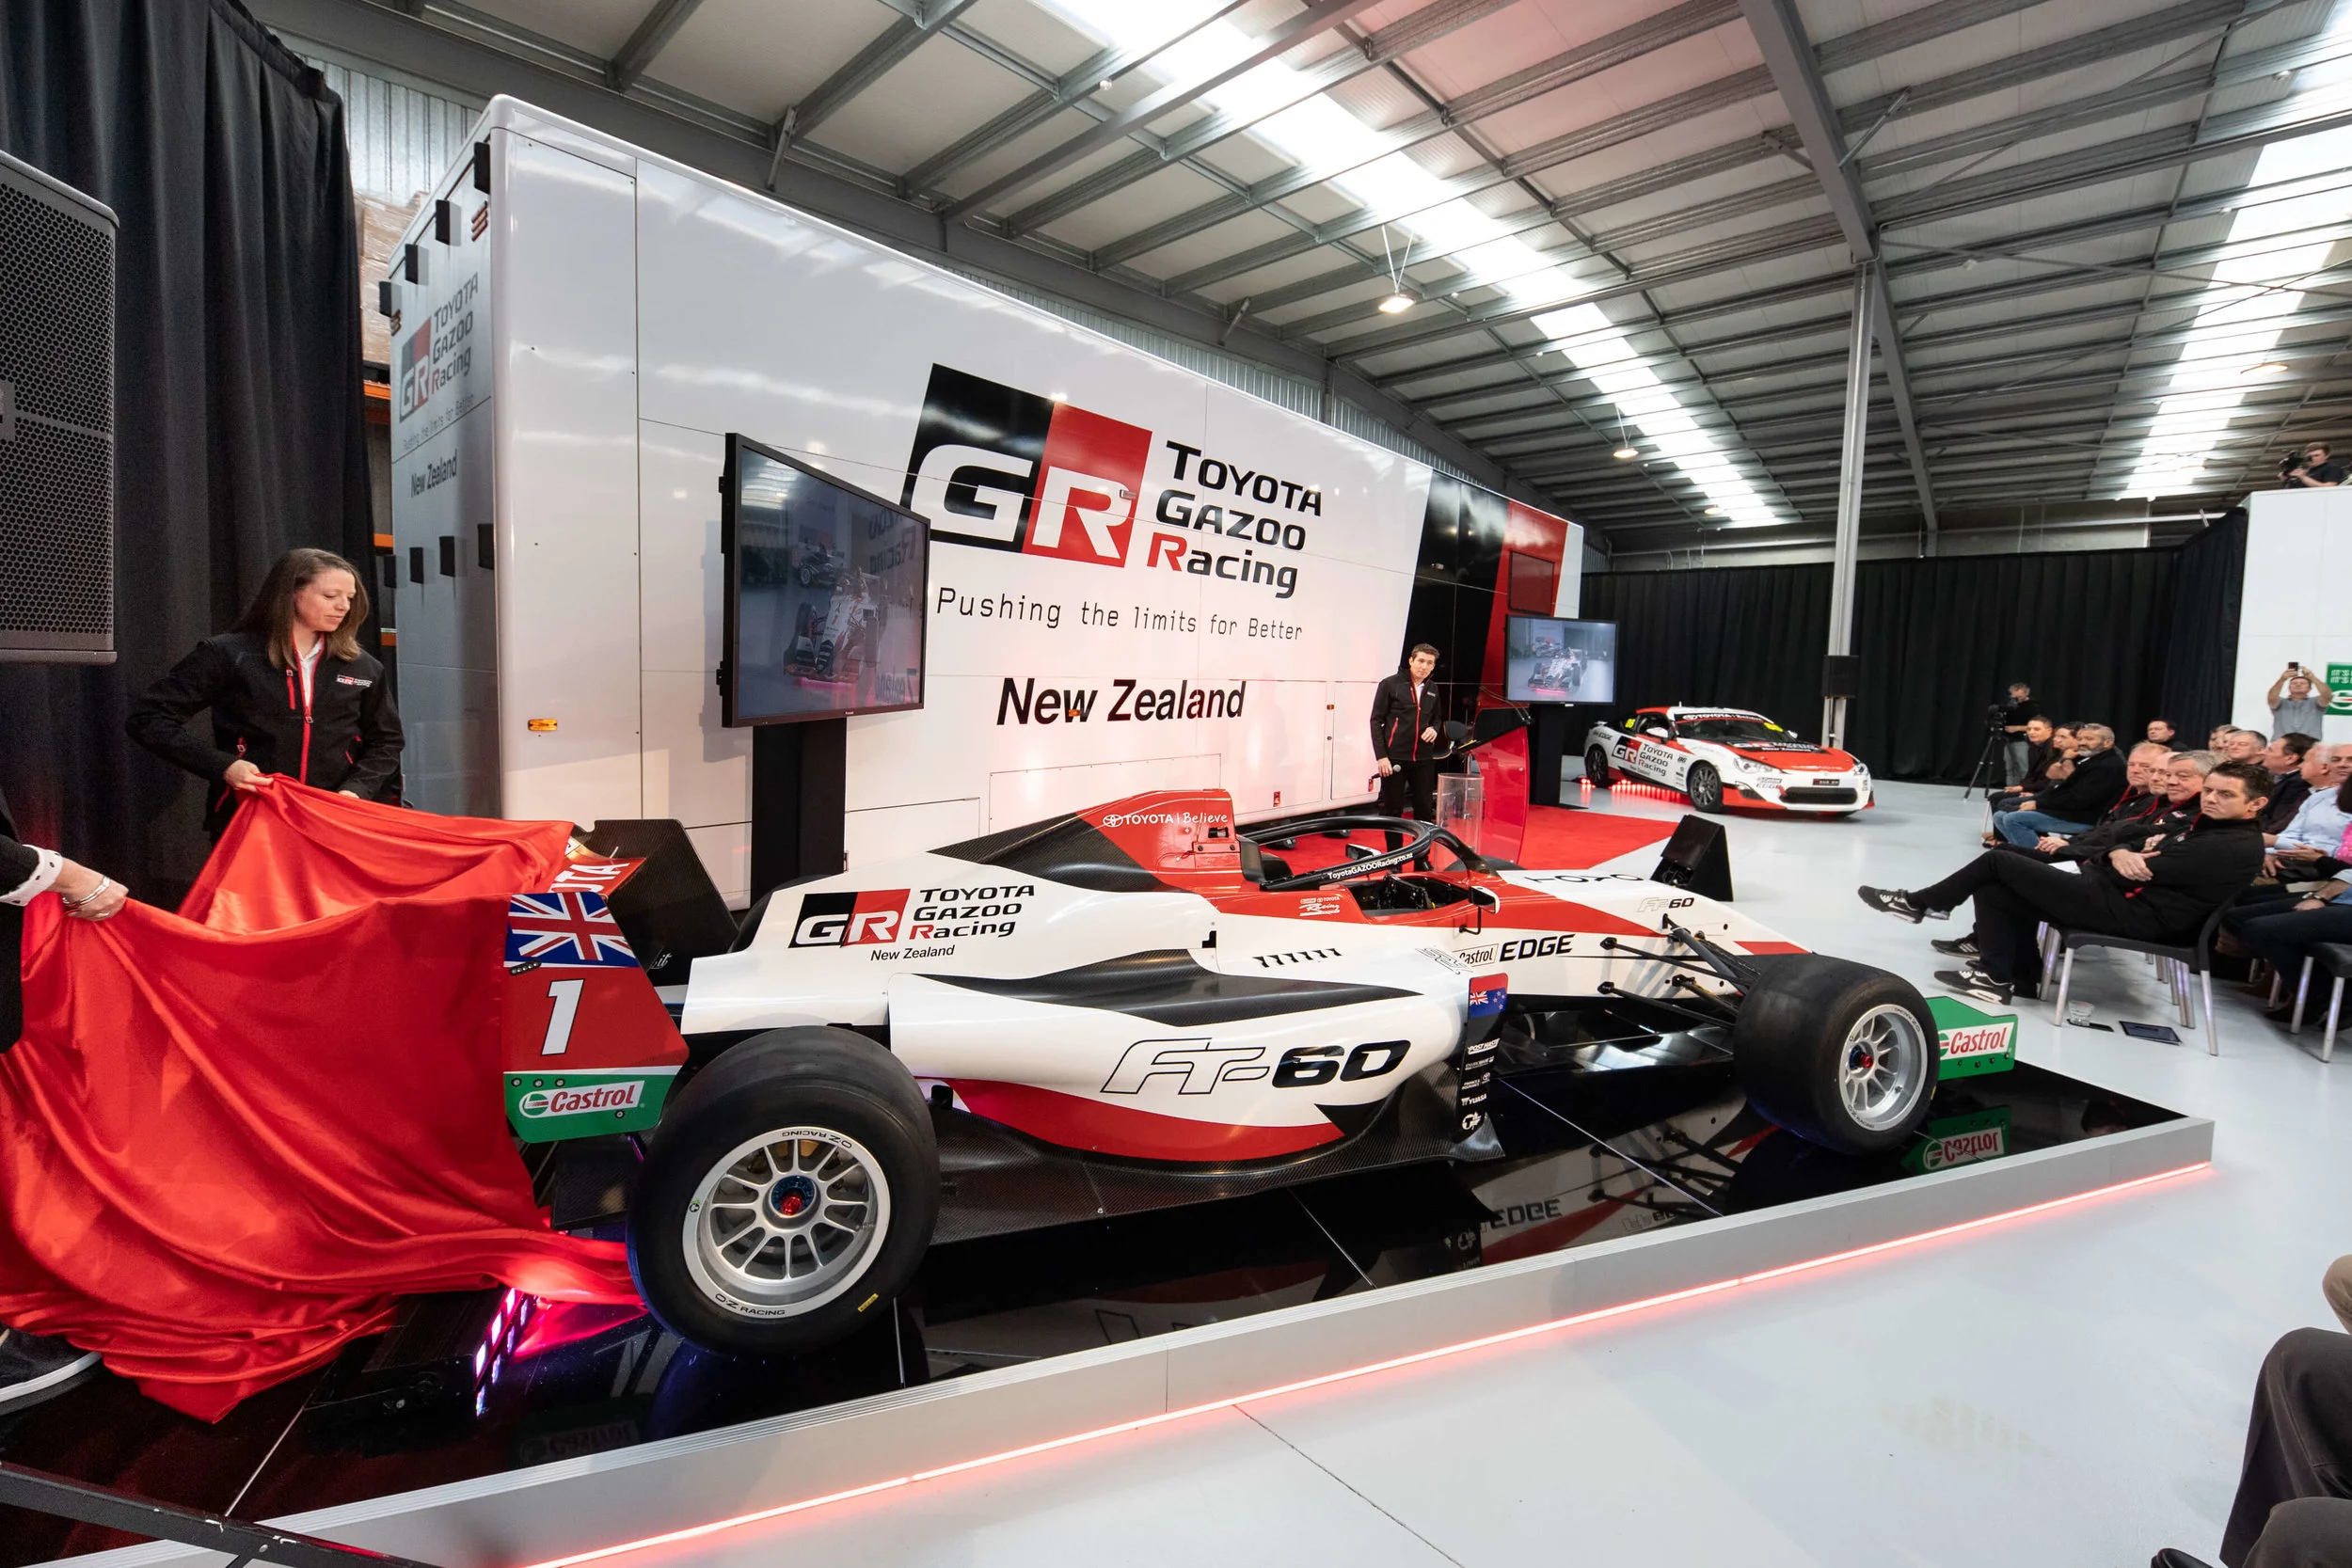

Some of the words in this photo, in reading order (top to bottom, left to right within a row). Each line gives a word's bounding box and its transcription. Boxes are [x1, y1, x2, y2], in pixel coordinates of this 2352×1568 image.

[434, 271, 478, 333] TOYOTA
[433, 310, 473, 364] GAZOO
[432, 346, 471, 394] Racing
[400, 355, 430, 420] GR
[411, 473, 426, 498] New
[427, 448, 457, 489] Zealand
[1166, 439, 1322, 516] TOYOTA
[911, 444, 1132, 559] GR
[1155, 489, 1306, 551] GAZOO
[1147, 531, 1298, 599] Racing
[937, 587, 1061, 629] Pushing
[1081, 601, 1120, 627] the
[1134, 607, 1197, 633] limits
[1210, 614, 1238, 636] for
[1248, 618, 1303, 641] Better
[996, 677, 1099, 726] New
[1106, 679, 1248, 722] Zealand
[1613, 744, 1637, 764] GR
[1640, 752, 1669, 767] GAZOO
[1643, 744, 1674, 760] TOYOTA
[1639, 759, 1666, 777] Racing
[1124, 814, 1173, 825] TOYOTA
[1183, 812, 1228, 824] Believe
[548, 863, 630, 893] OTA
[1327, 853, 1413, 879] ToyotaGAZOORacing.co.nz
[919, 885, 1035, 903] TOYOTA
[914, 903, 1022, 922] GAZOO
[796, 911, 901, 946] GR
[909, 921, 1016, 940] Racing
[870, 949, 899, 961] New
[903, 944, 955, 959] Zealand
[1500, 934, 1576, 962] EDGE
[541, 978, 585, 1056] 1
[1950, 1027, 2007, 1054] Castrol
[550, 1085, 635, 1113] Castrol
[1469, 1094, 1486, 1104] YUASA
[740, 1307, 786, 1316] RACING
